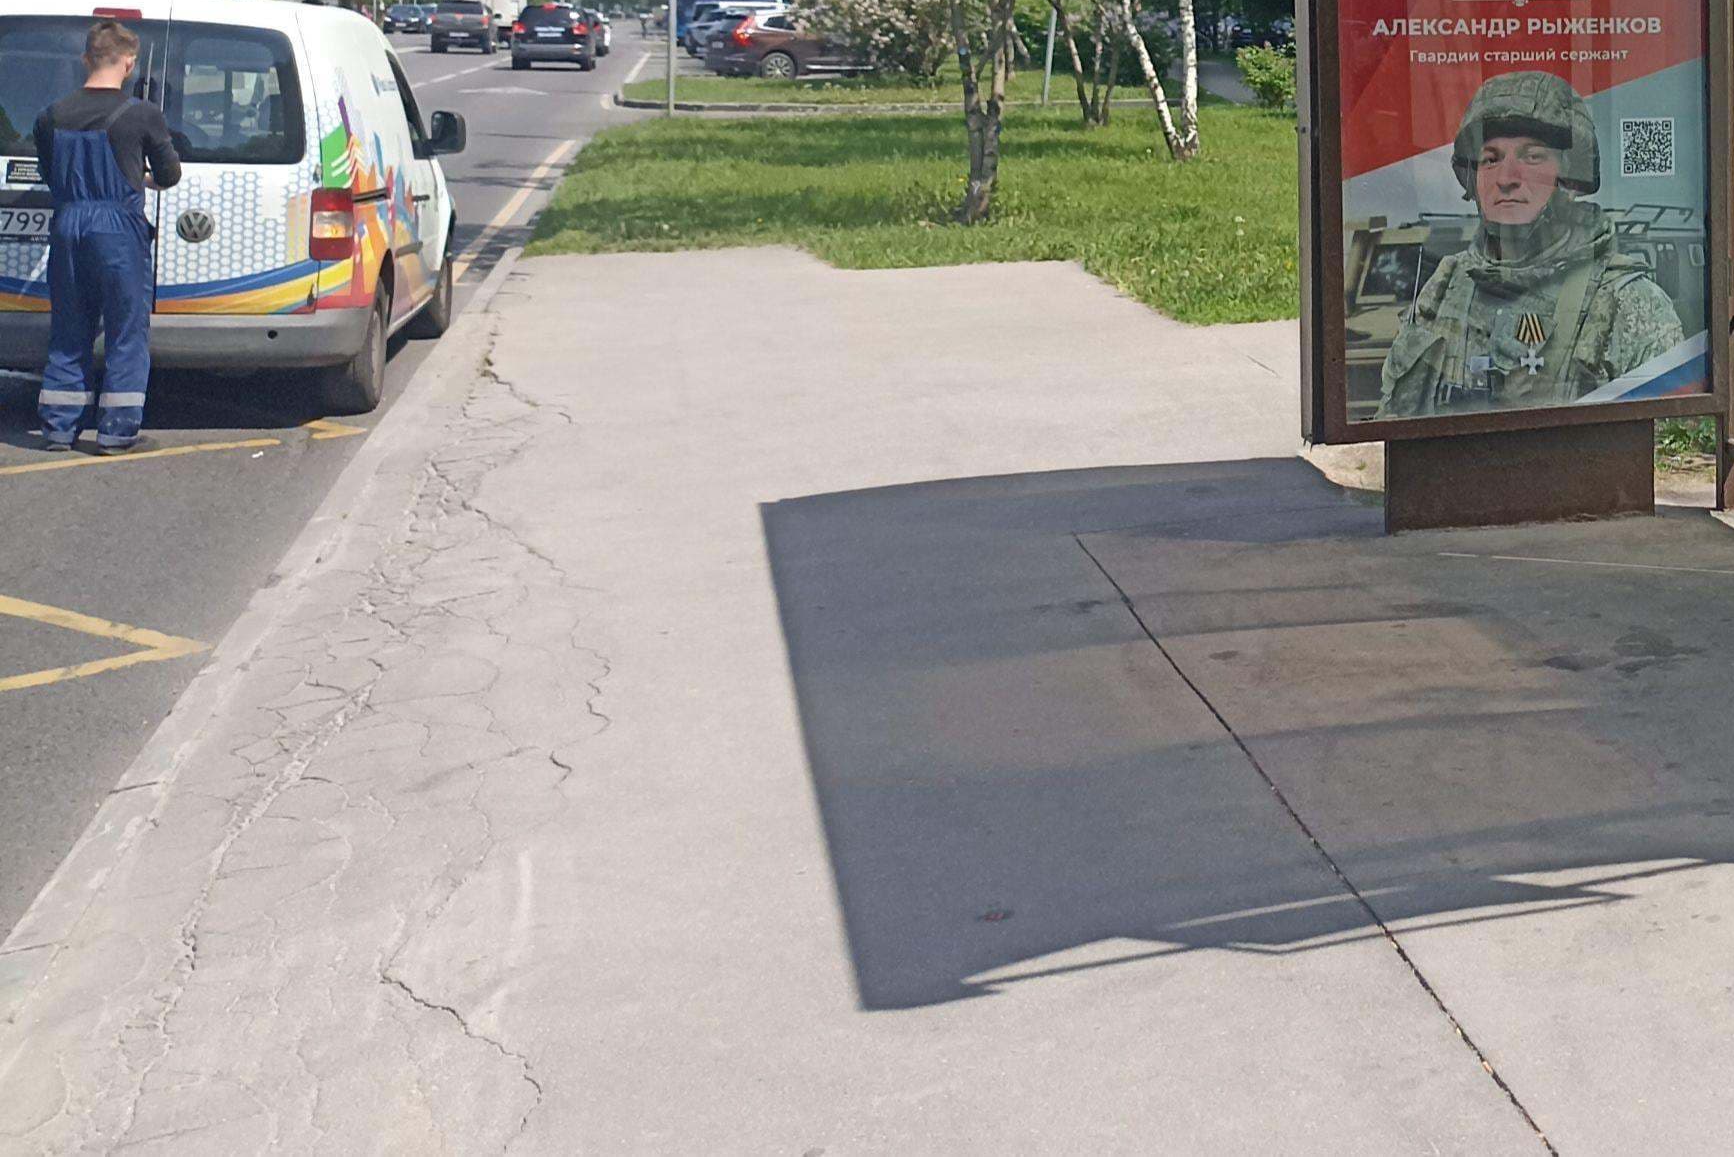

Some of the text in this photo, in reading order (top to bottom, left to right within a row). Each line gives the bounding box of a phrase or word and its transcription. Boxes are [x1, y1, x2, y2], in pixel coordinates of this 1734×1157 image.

[1372, 16, 1662, 38] АЛЕКСАНДР РЫЖЕНКОВ
[1409, 47, 1629, 65] Гвардии старший сержант
[1, 211, 46, 232] 799
